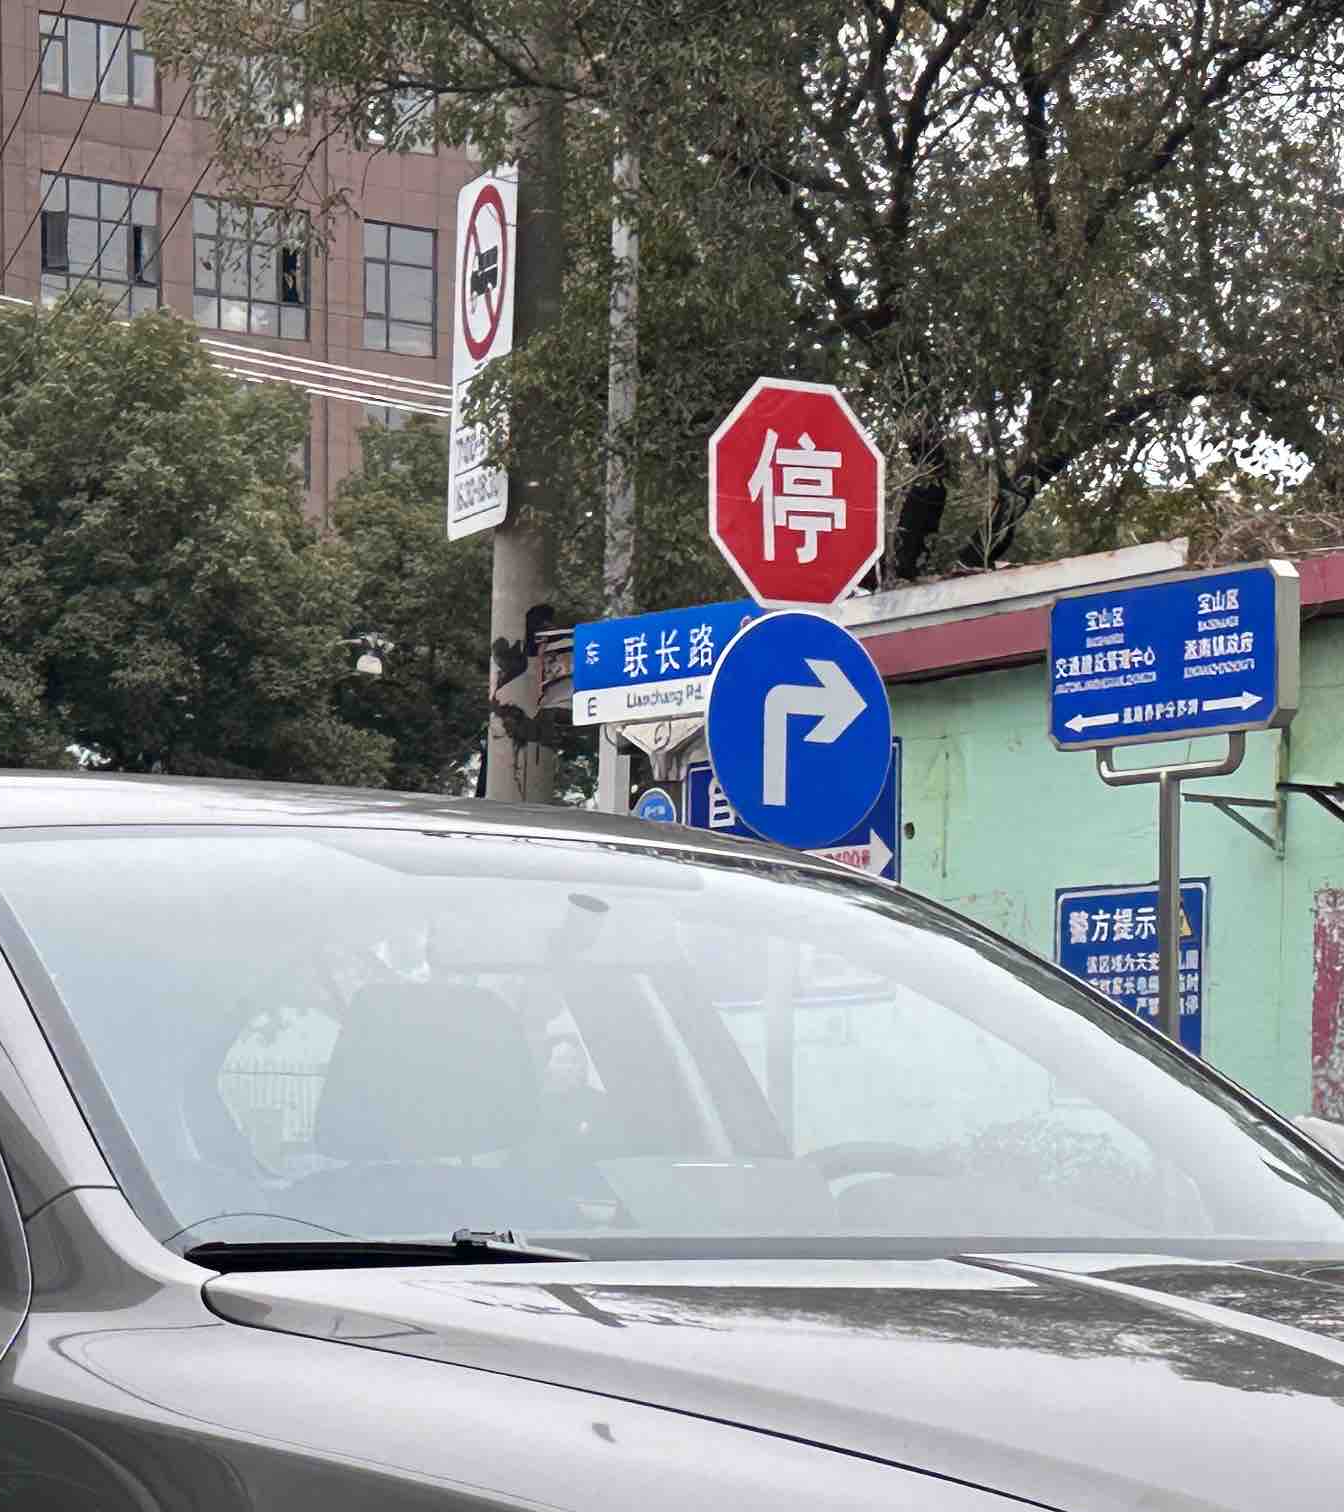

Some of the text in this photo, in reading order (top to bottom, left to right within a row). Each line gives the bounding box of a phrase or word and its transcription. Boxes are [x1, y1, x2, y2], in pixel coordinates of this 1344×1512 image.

[747, 428, 847, 564] 停
[623, 623, 716, 679] 联长路
[587, 697, 597, 717] E
[1069, 907, 1157, 944] 警方提示
